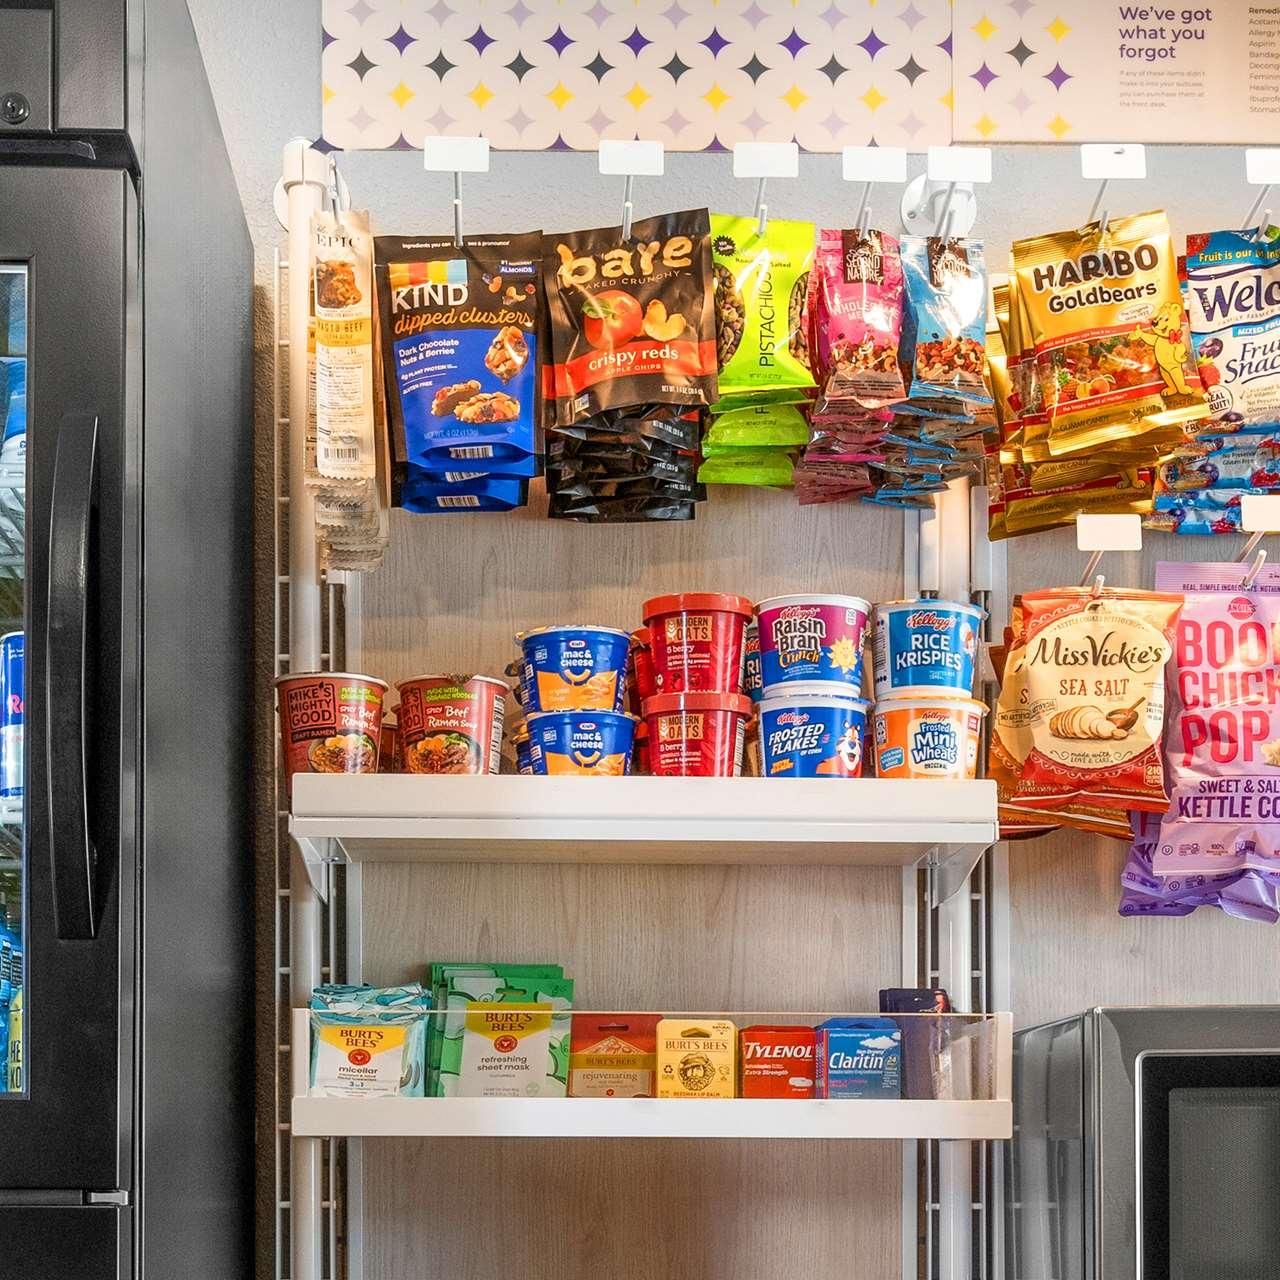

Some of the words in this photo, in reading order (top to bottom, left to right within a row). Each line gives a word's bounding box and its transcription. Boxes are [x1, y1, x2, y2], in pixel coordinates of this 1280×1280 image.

[1119, 6, 1174, 21] We've
[1181, 8, 1212, 24] got
[1119, 26, 1166, 40] what
[1171, 29, 1205, 43] you
[1249, 30, 1274, 38] Allergy
[1119, 44, 1176, 61] forgot
[1249, 84, 1278, 92] Healing
[556, 235, 693, 288] bare
[1033, 244, 1159, 292] HARIBO
[392, 282, 468, 314] KIND
[1048, 281, 1157, 315] Goldbears
[395, 310, 455, 334] dipped
[459, 308, 534, 328] clusters
[588, 350, 634, 372] crispy
[636, 345, 679, 363] reds
[772, 617, 825, 639] Raisin
[776, 634, 820, 651] Bran
[911, 634, 950, 650] RICE
[779, 650, 821, 666] Crunch
[896, 650, 961, 671] KRISPIES
[288, 685, 332, 702] MIKE'S
[1059, 678, 1087, 696] SEA
[1094, 678, 1130, 696] SALT
[290, 699, 330, 713] MIGHTY
[768, 724, 824, 746] FROSTED
[921, 723, 951, 734] Frosted
[915, 732, 956, 750] Mini
[1181, 709, 1271, 767] POP
[771, 738, 819, 757] FLAKES
[911, 747, 957, 764] Wheats
[1178, 797, 1251, 820] KETTLE
[485, 1011, 533, 1023] BURT'S
[339, 1028, 384, 1040] BURT'S
[491, 1021, 528, 1032] BEES
[345, 1038, 378, 1049] BEES
[745, 1042, 813, 1060] TYLENOL
[481, 1056, 527, 1065] refreshing
[829, 1051, 884, 1071] Claritin
[338, 1066, 378, 1075] micellar
